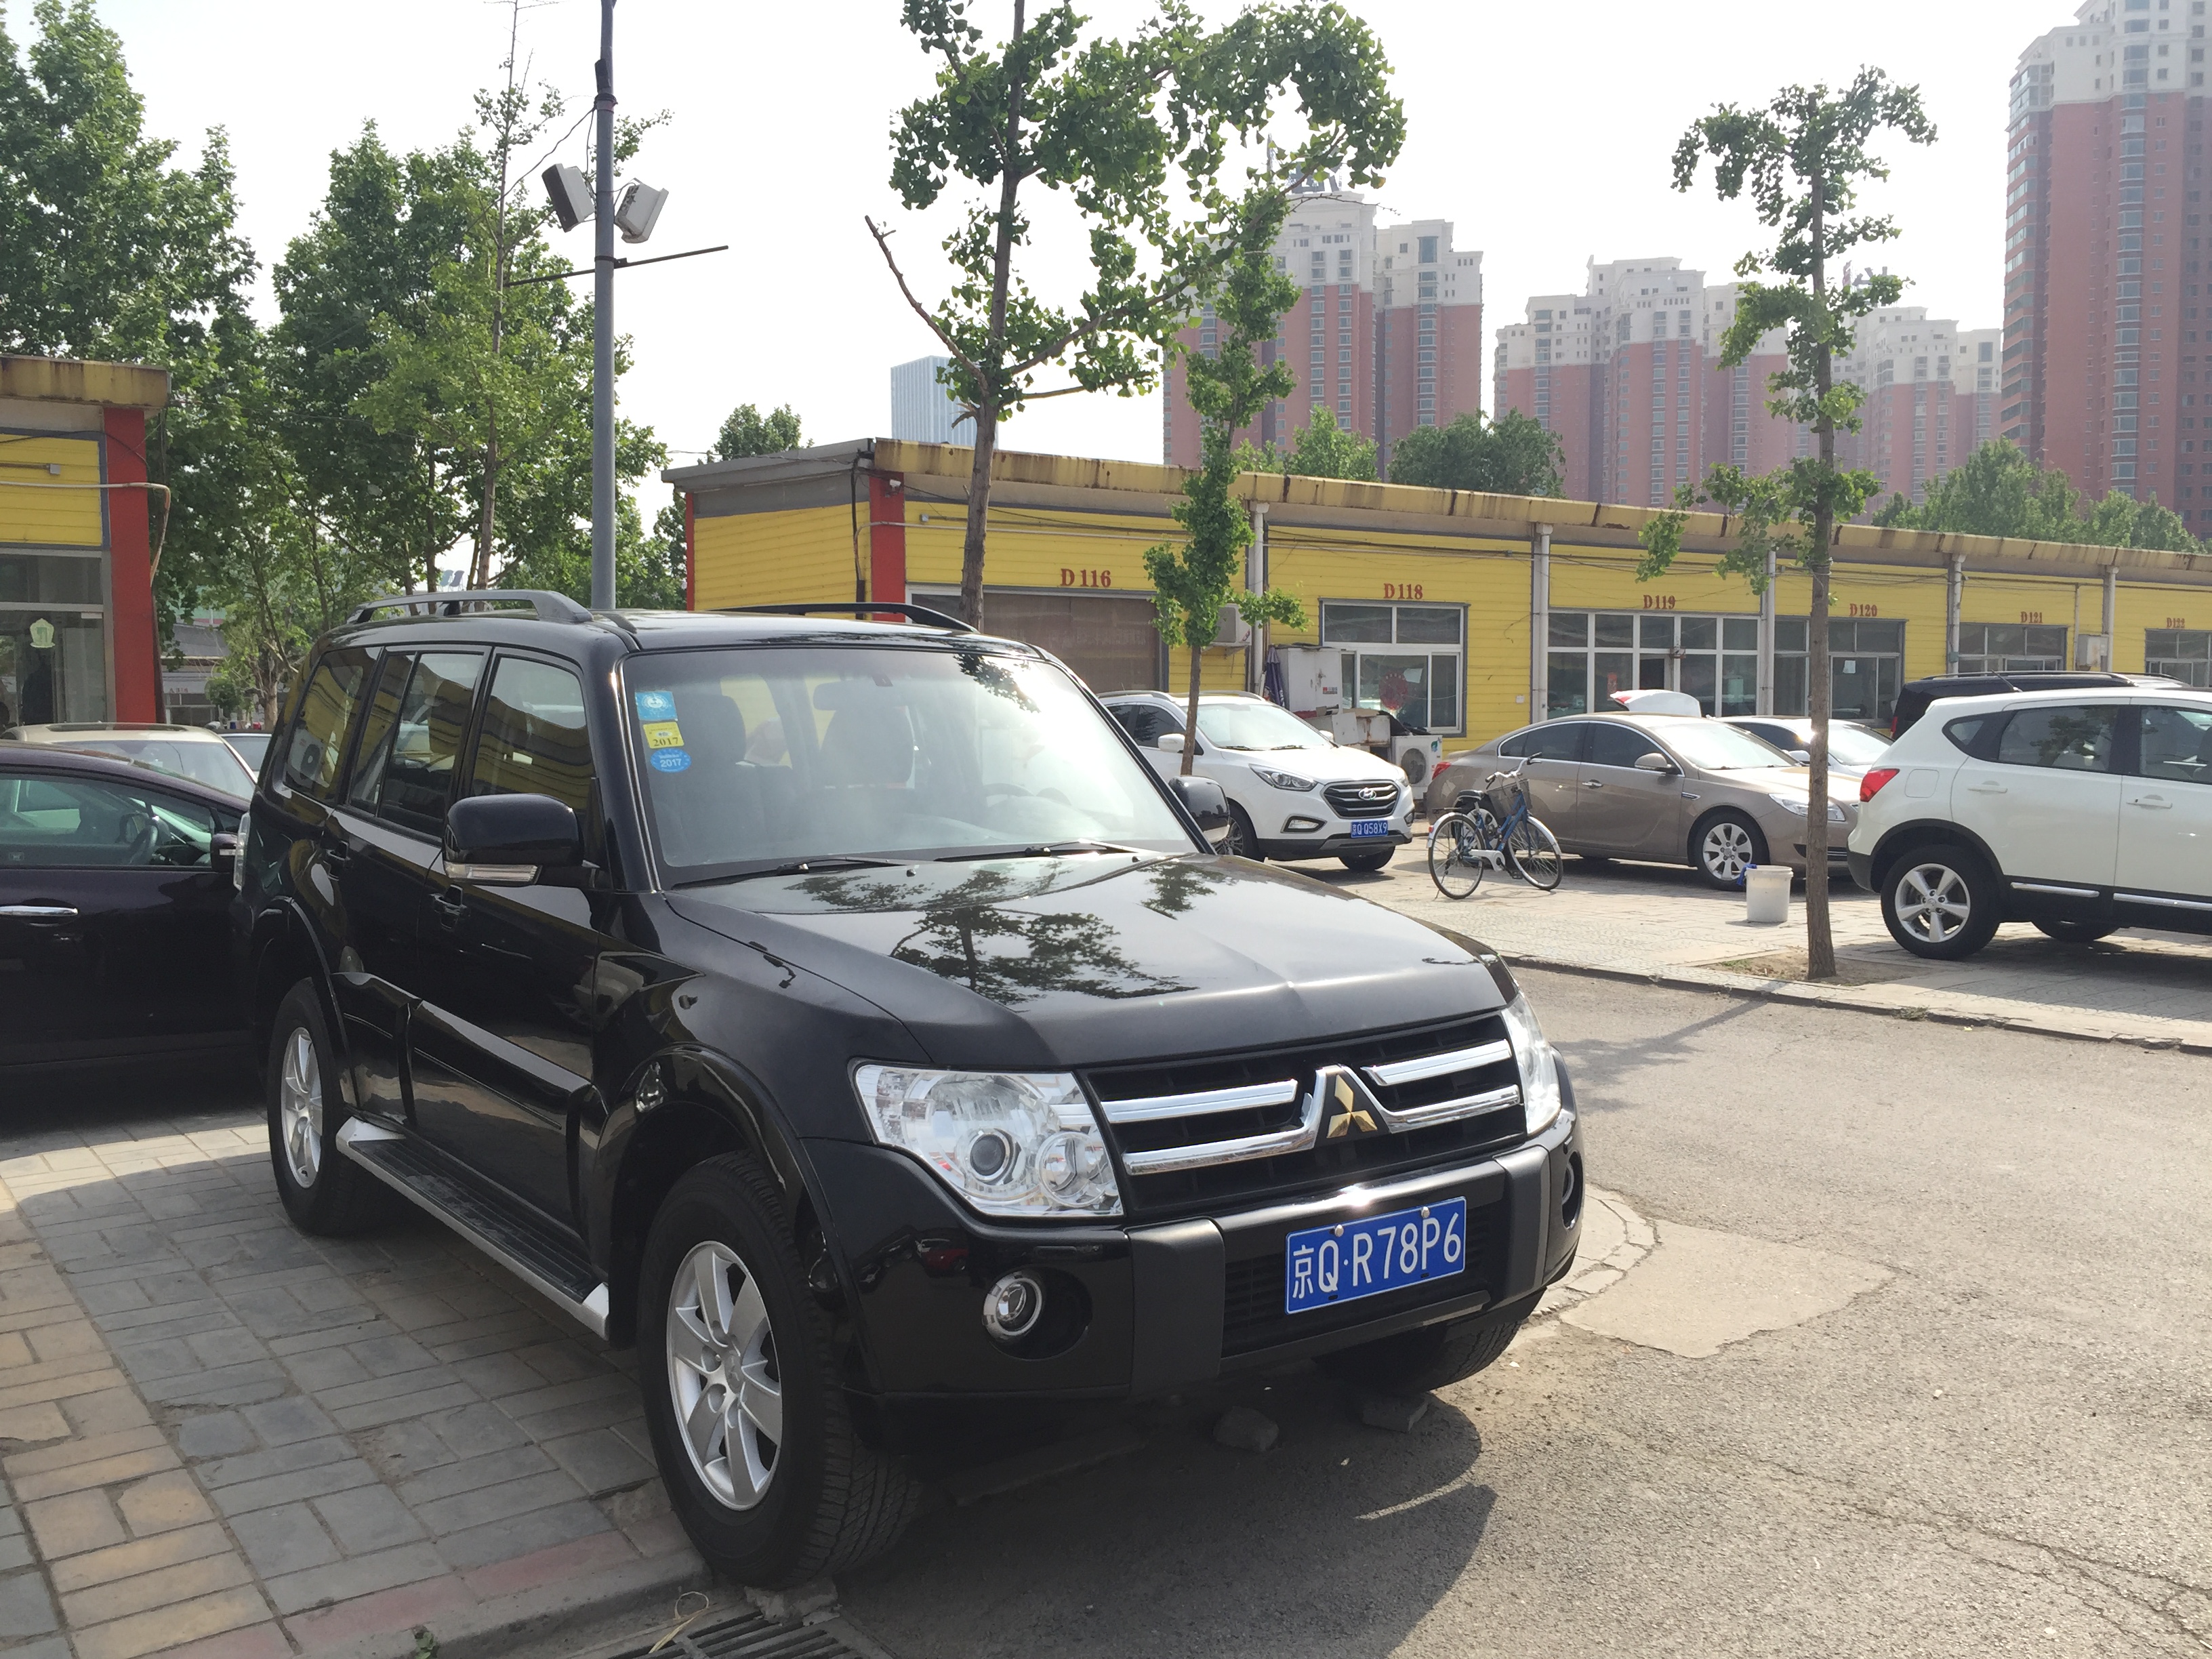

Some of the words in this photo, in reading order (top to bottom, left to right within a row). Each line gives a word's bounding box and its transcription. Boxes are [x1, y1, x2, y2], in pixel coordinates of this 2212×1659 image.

[1060, 568, 1111, 588] D116
[1383, 583, 1423, 600] D118
[1643, 594, 1675, 609] D119
[1849, 603, 1878, 617] D120
[2020, 611, 2043, 623] D121
[653, 737, 678, 746] 2017
[660, 758, 682, 767] 2017
